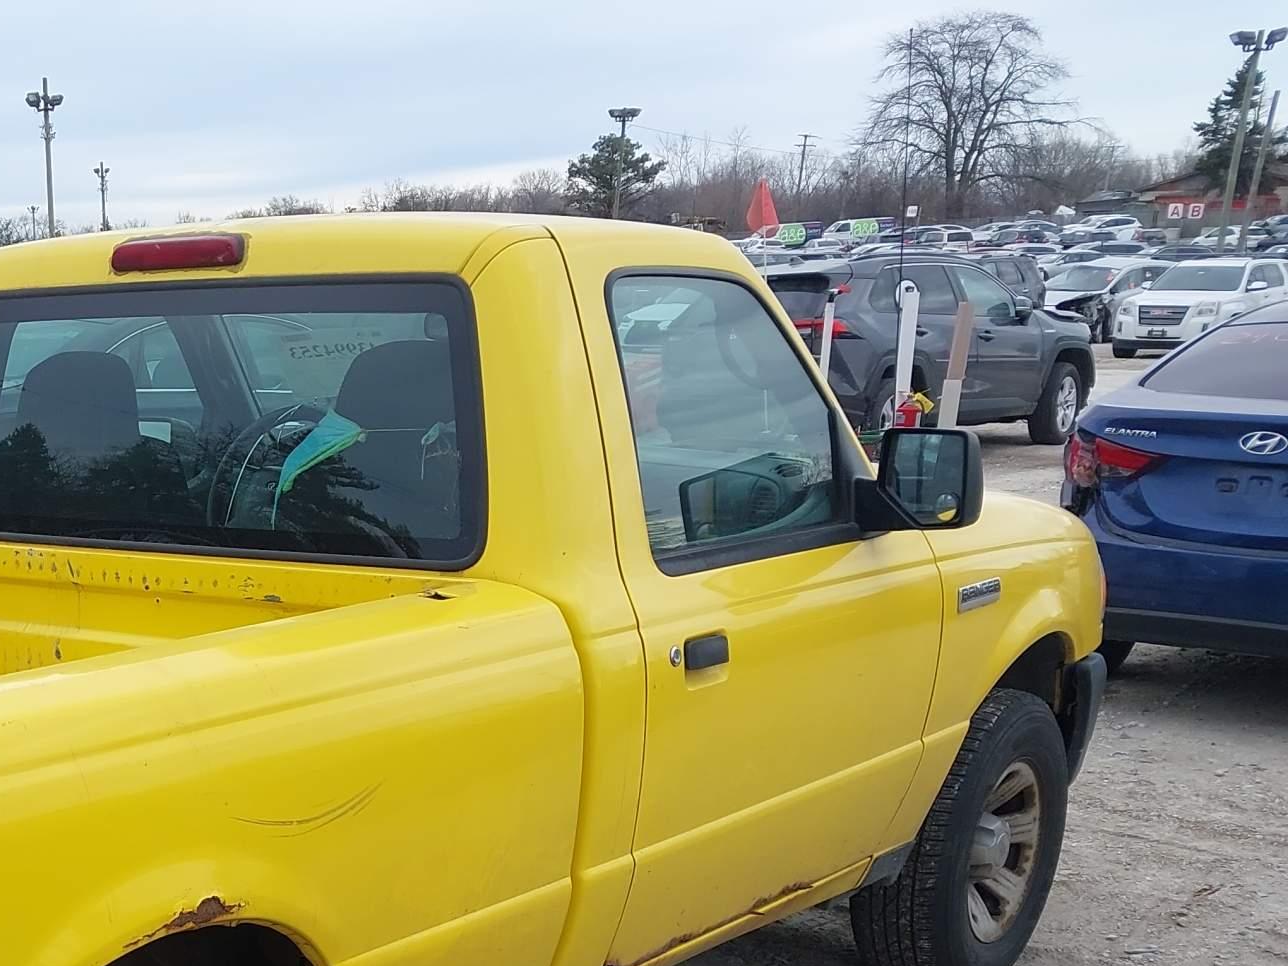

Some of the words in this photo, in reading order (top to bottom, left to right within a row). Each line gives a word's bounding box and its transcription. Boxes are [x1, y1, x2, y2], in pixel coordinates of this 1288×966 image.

[1170, 205, 1180, 217] A
[1191, 205, 1201, 217] B
[780, 228, 806, 242] a&e
[854, 222, 879, 236] a&e
[1104, 427, 1158, 439] ELANTRA
[961, 579, 1001, 604] RANGER
